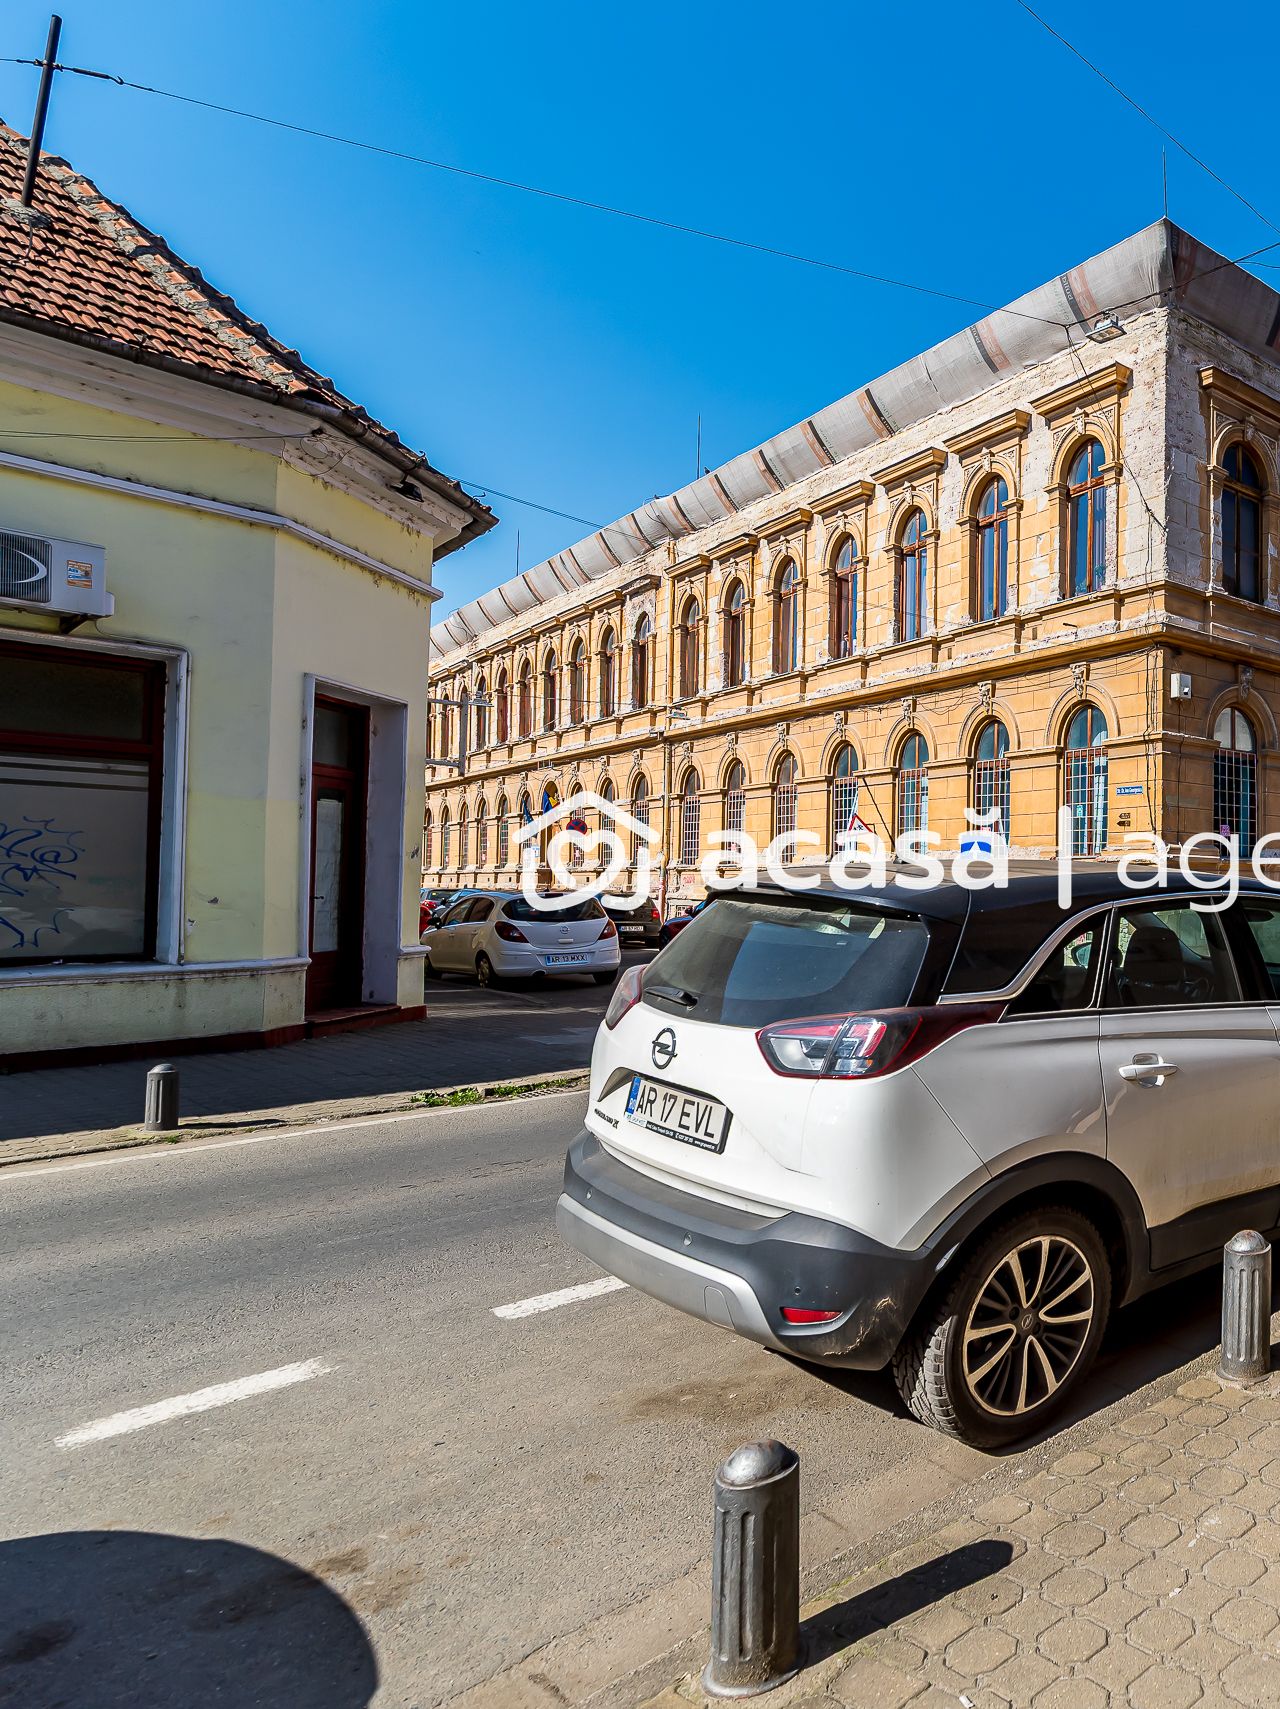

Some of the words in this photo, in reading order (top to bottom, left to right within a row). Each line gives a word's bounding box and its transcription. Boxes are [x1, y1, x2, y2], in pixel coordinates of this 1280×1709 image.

[636, 1084, 657, 1117] AR
[660, 1092, 677, 1122] 17
[678, 1099, 715, 1138] EVL
